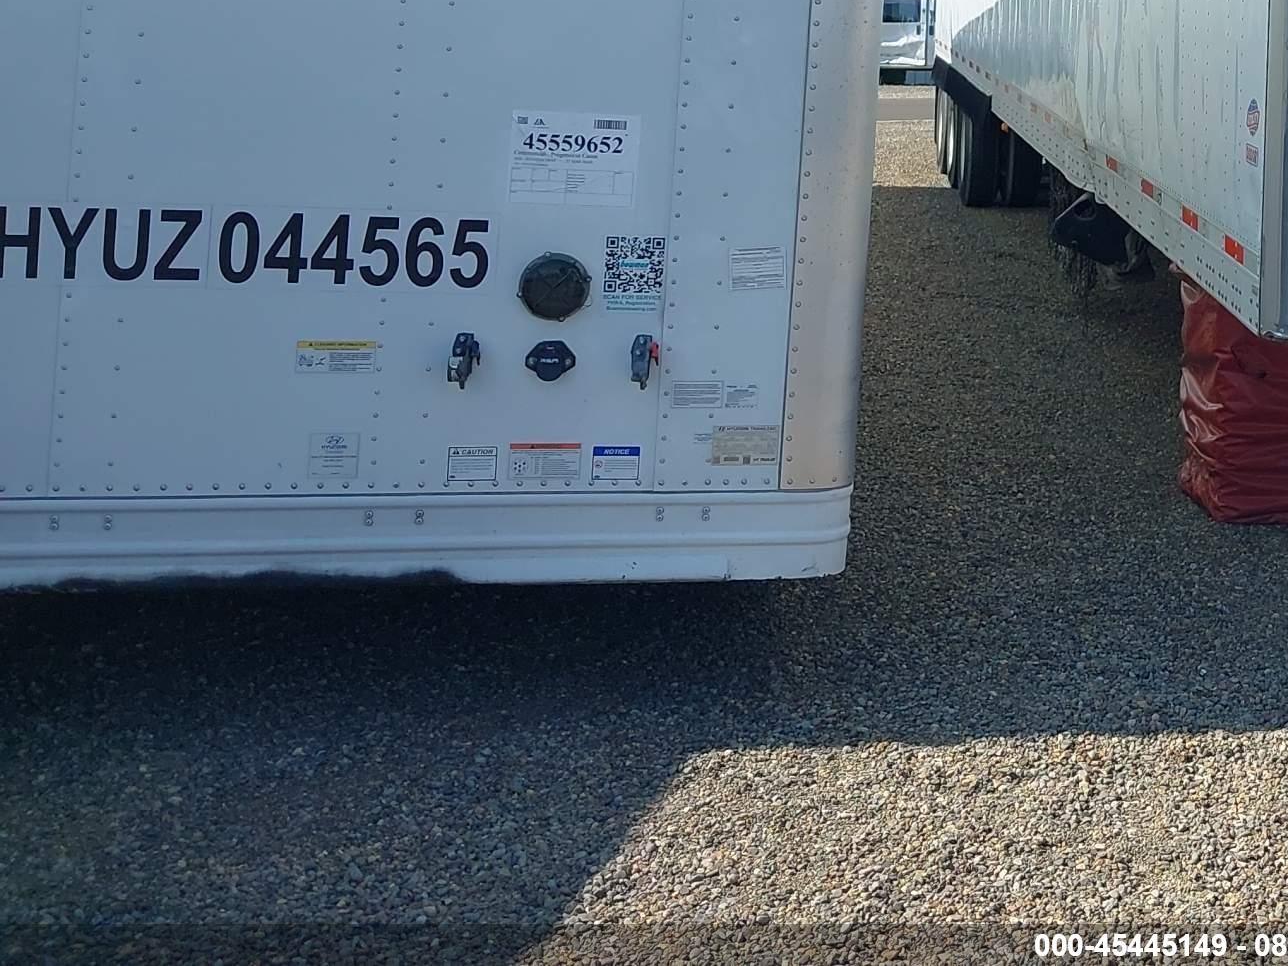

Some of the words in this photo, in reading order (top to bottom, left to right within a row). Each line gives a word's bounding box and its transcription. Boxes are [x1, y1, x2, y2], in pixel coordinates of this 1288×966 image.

[523, 132, 624, 153] 45559652
[0, 206, 203, 281] HYUZ
[218, 211, 490, 289] 044565
[461, 448, 494, 456] CAUTION
